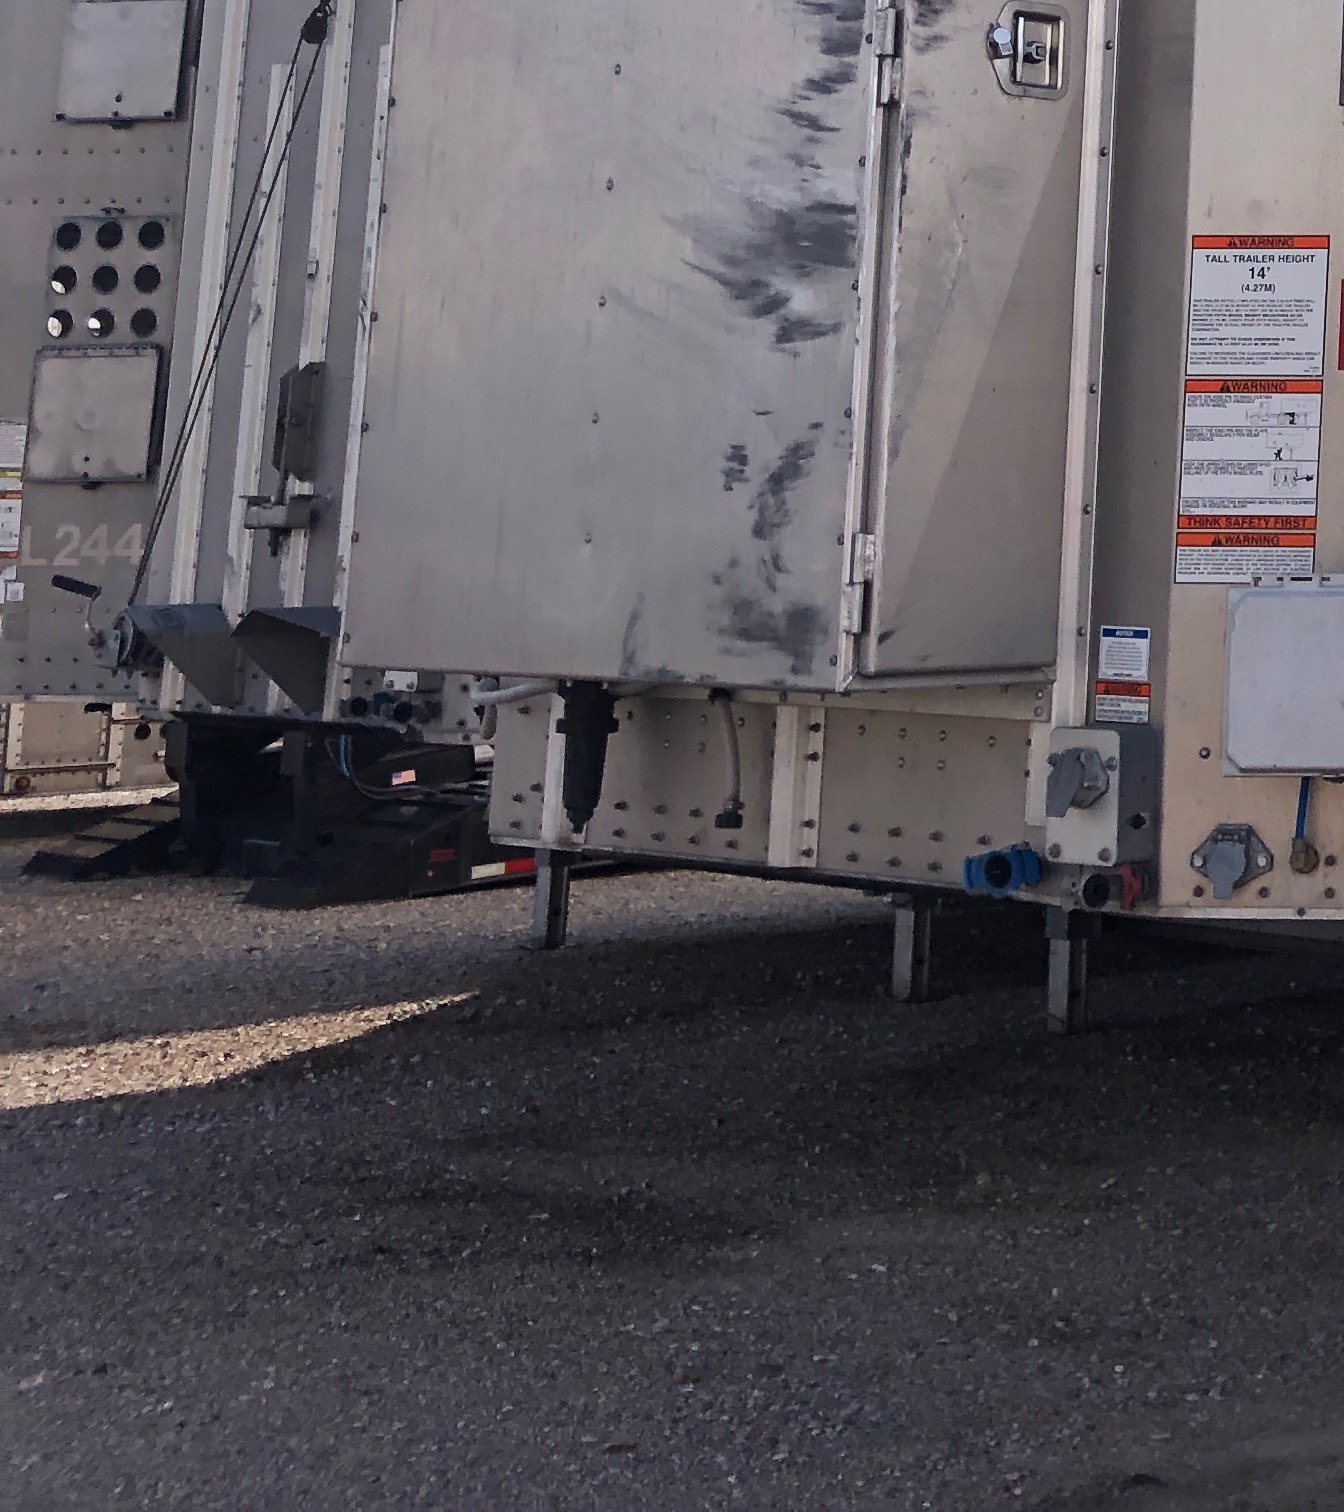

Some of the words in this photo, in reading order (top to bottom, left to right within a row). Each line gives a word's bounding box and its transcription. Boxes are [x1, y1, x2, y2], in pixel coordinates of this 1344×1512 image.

[1240, 238, 1294, 247] WARNING
[1205, 255, 1229, 263] TALL
[1233, 255, 1274, 263] TRAILER
[1278, 255, 1315, 263] HEIGHT
[1242, 284, 1276, 293] (4.27M)
[1232, 382, 1287, 392] WARNING
[1188, 517, 1220, 527] THINK
[1225, 517, 1273, 527] SAFETY
[1275, 517, 1308, 527] FIRST
[22, 523, 145, 567] L244
[1225, 536, 1280, 546] WARNING
